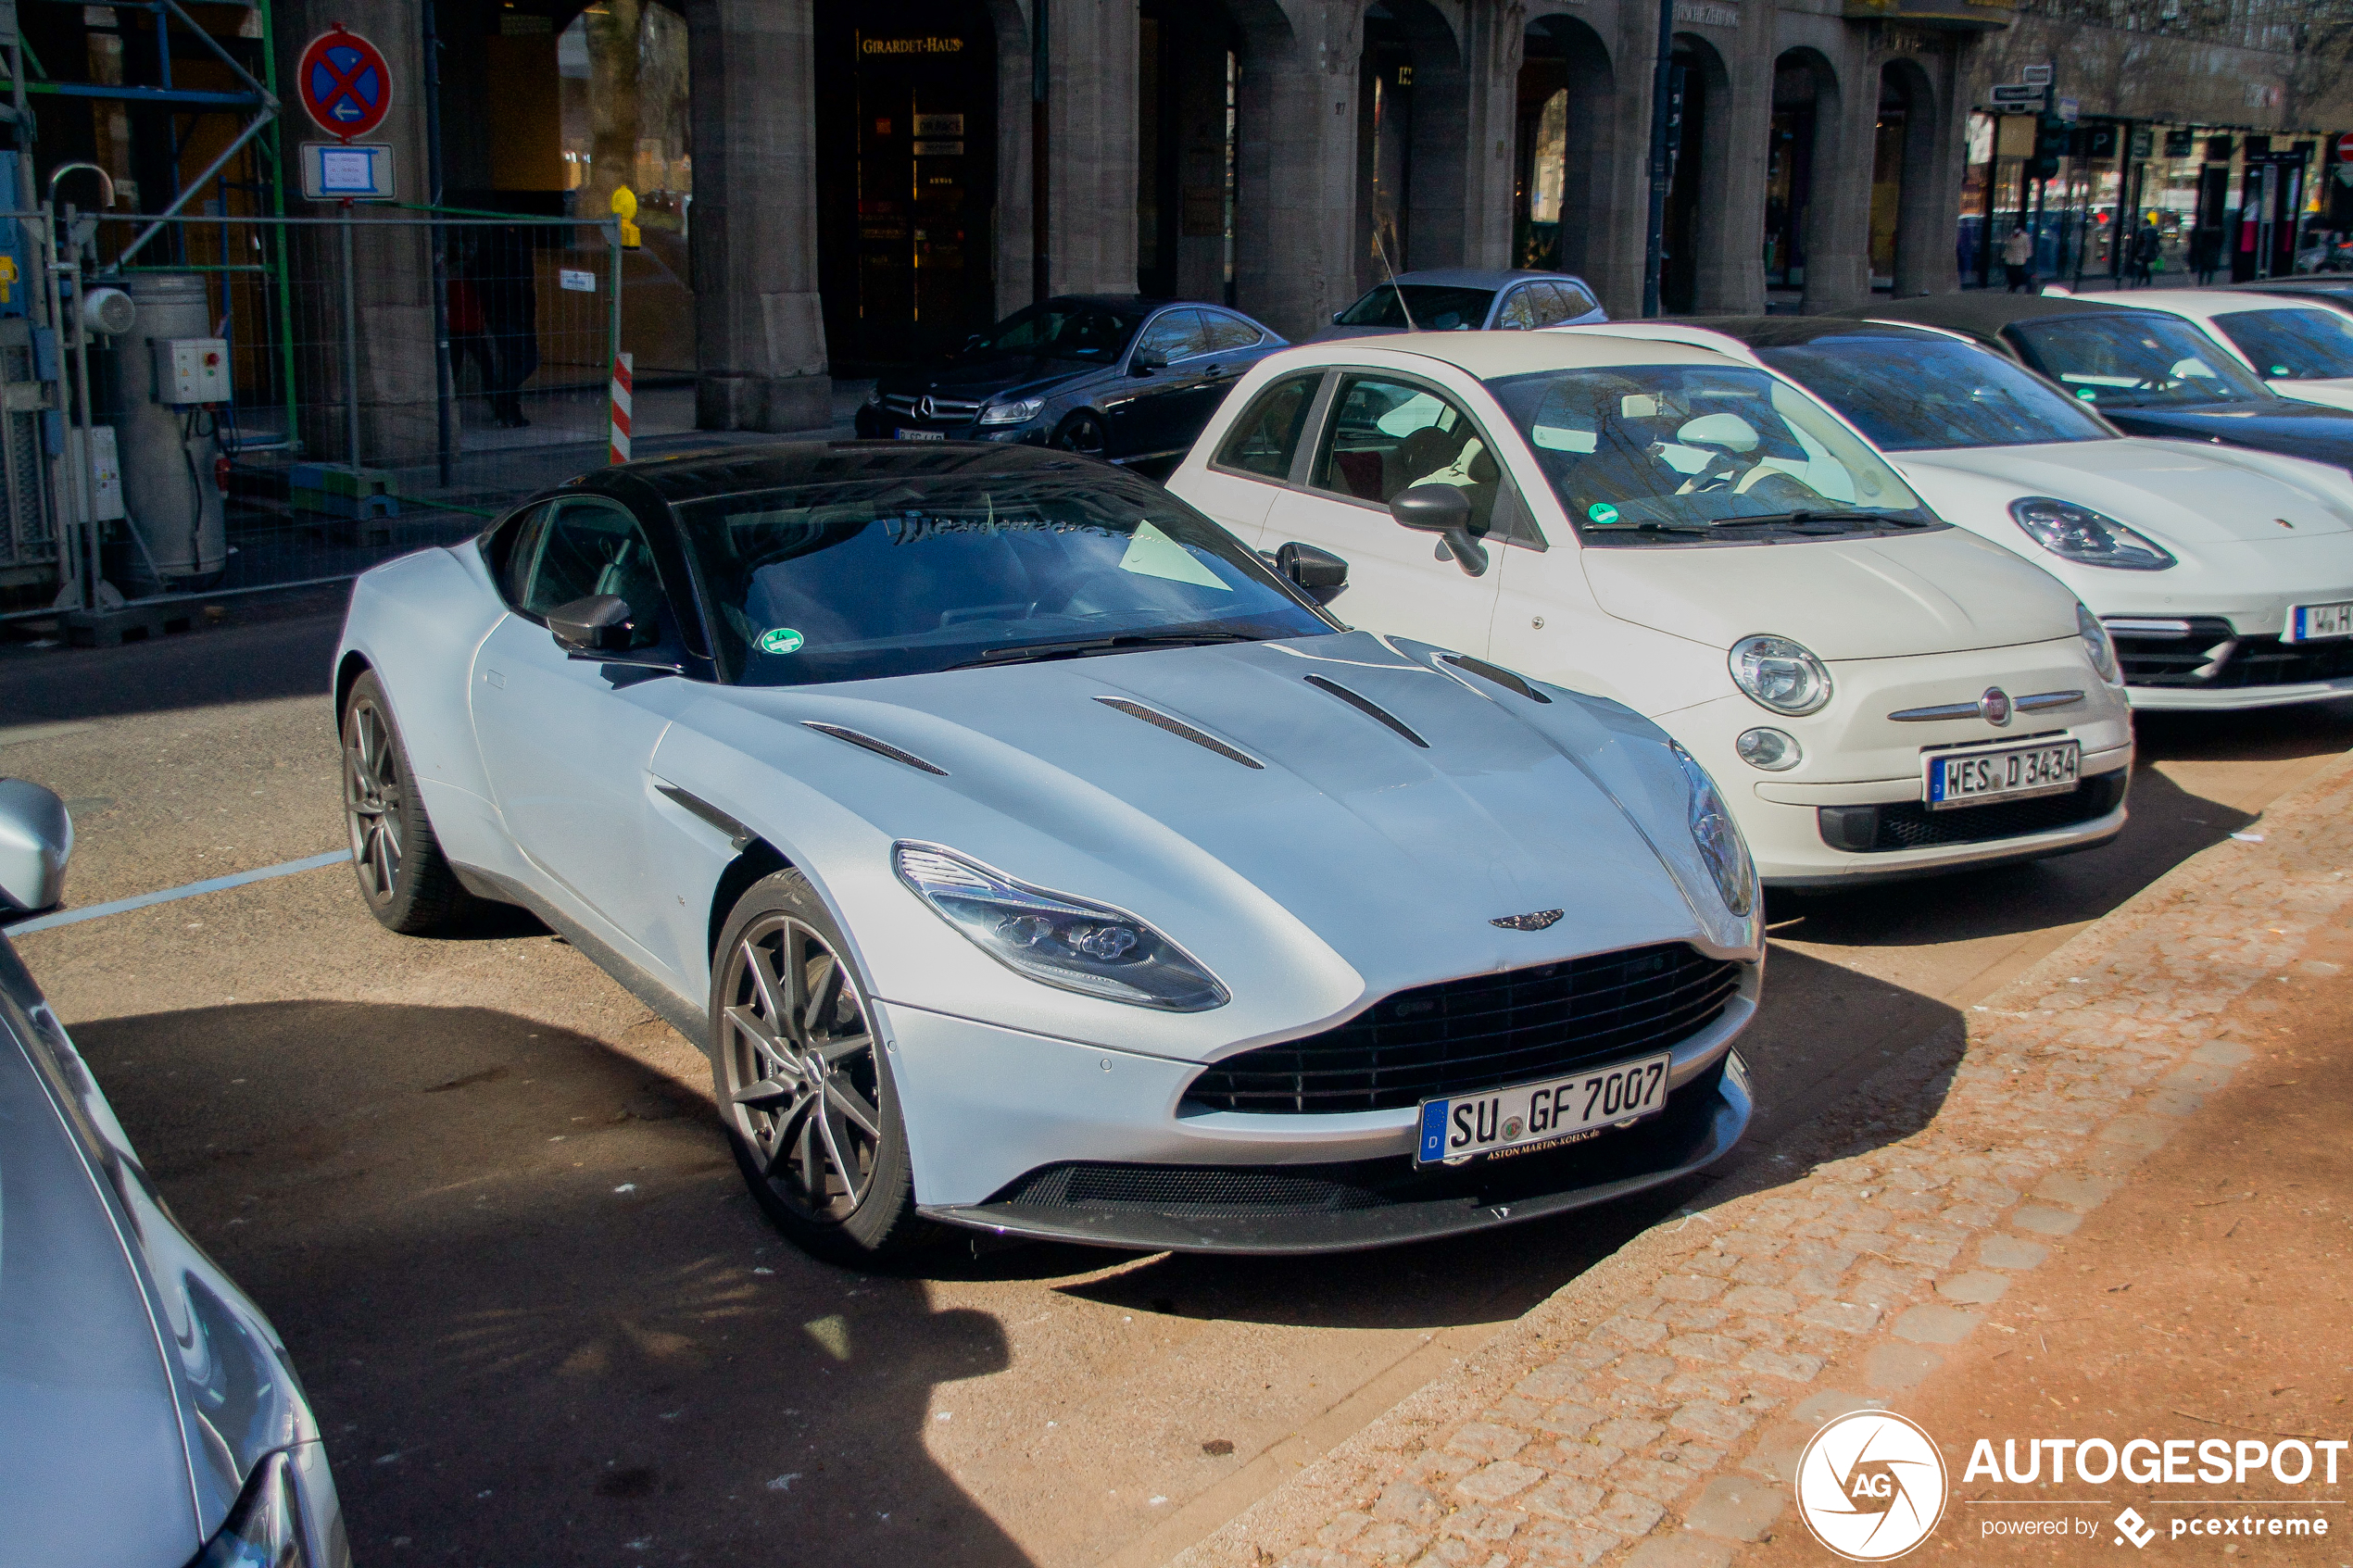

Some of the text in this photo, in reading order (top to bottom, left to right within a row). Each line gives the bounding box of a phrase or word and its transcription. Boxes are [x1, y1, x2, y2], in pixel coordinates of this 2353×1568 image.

[1945, 746, 2075, 795] WES D 3434
[1451, 1061, 1665, 1148] SU GF 7007
[1428, 1135, 1438, 1149] D
[1487, 1147, 1521, 1161] ASTON
